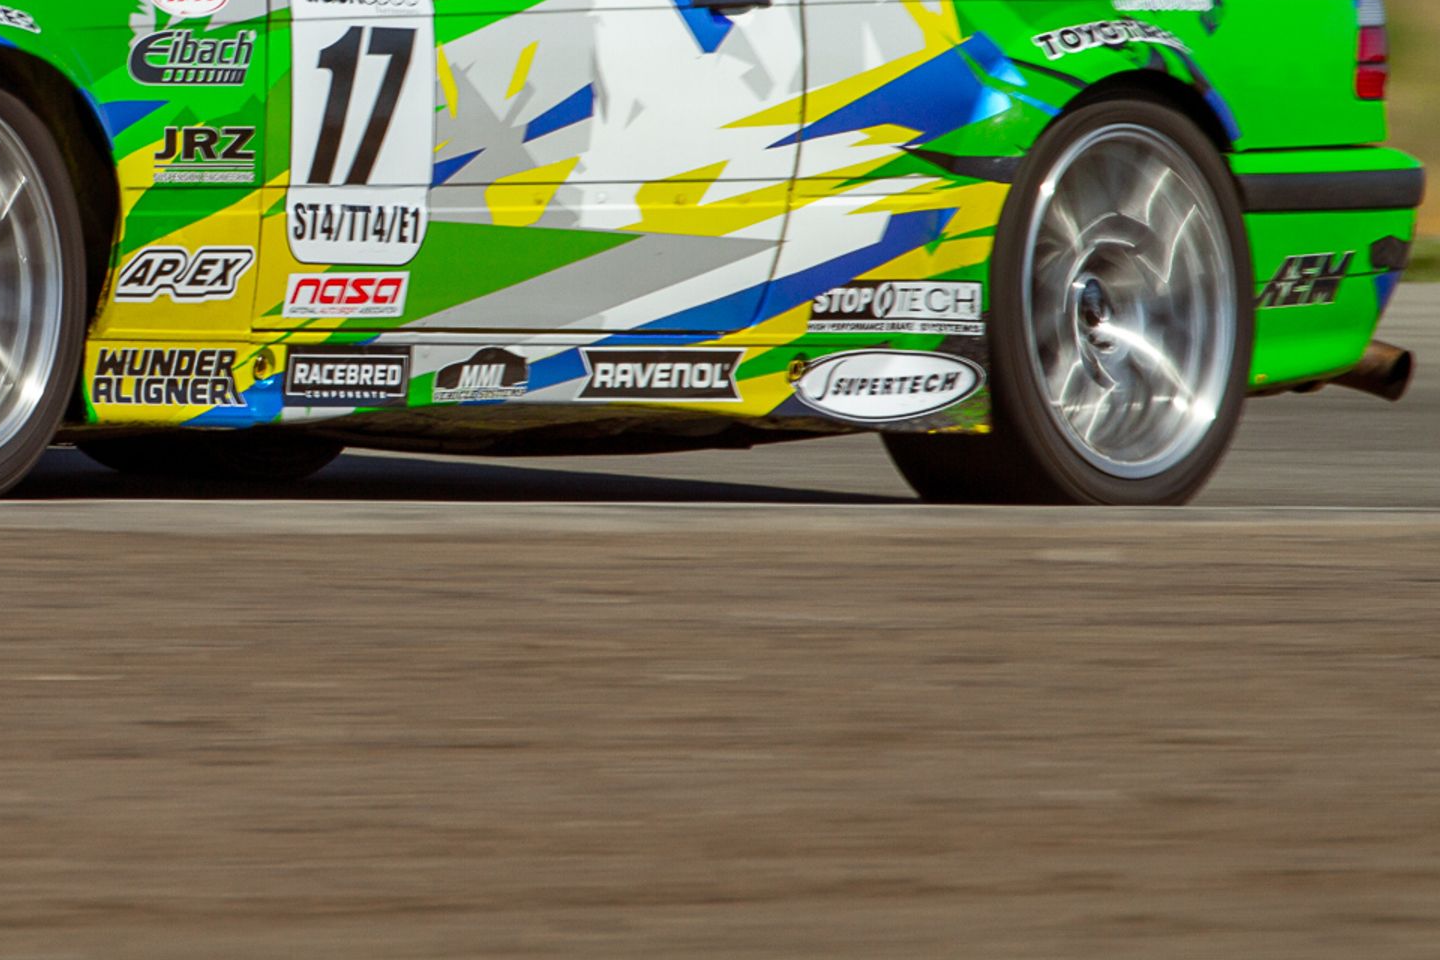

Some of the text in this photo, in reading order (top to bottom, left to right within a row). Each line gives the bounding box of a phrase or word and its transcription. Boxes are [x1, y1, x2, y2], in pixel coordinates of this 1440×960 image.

[129, 29, 256, 85] Eibach
[306, 26, 419, 187] 17
[154, 126, 256, 160] JRZ
[293, 202, 420, 244] ST4/TT4/E1
[120, 258, 243, 287] APEX
[94, 348, 237, 377] WUNDER
[293, 363, 402, 386] RACEBRED
[592, 362, 730, 389] RAVENOL
[92, 377, 240, 405] ALIGNER
[827, 369, 962, 397] SUPERTECH
